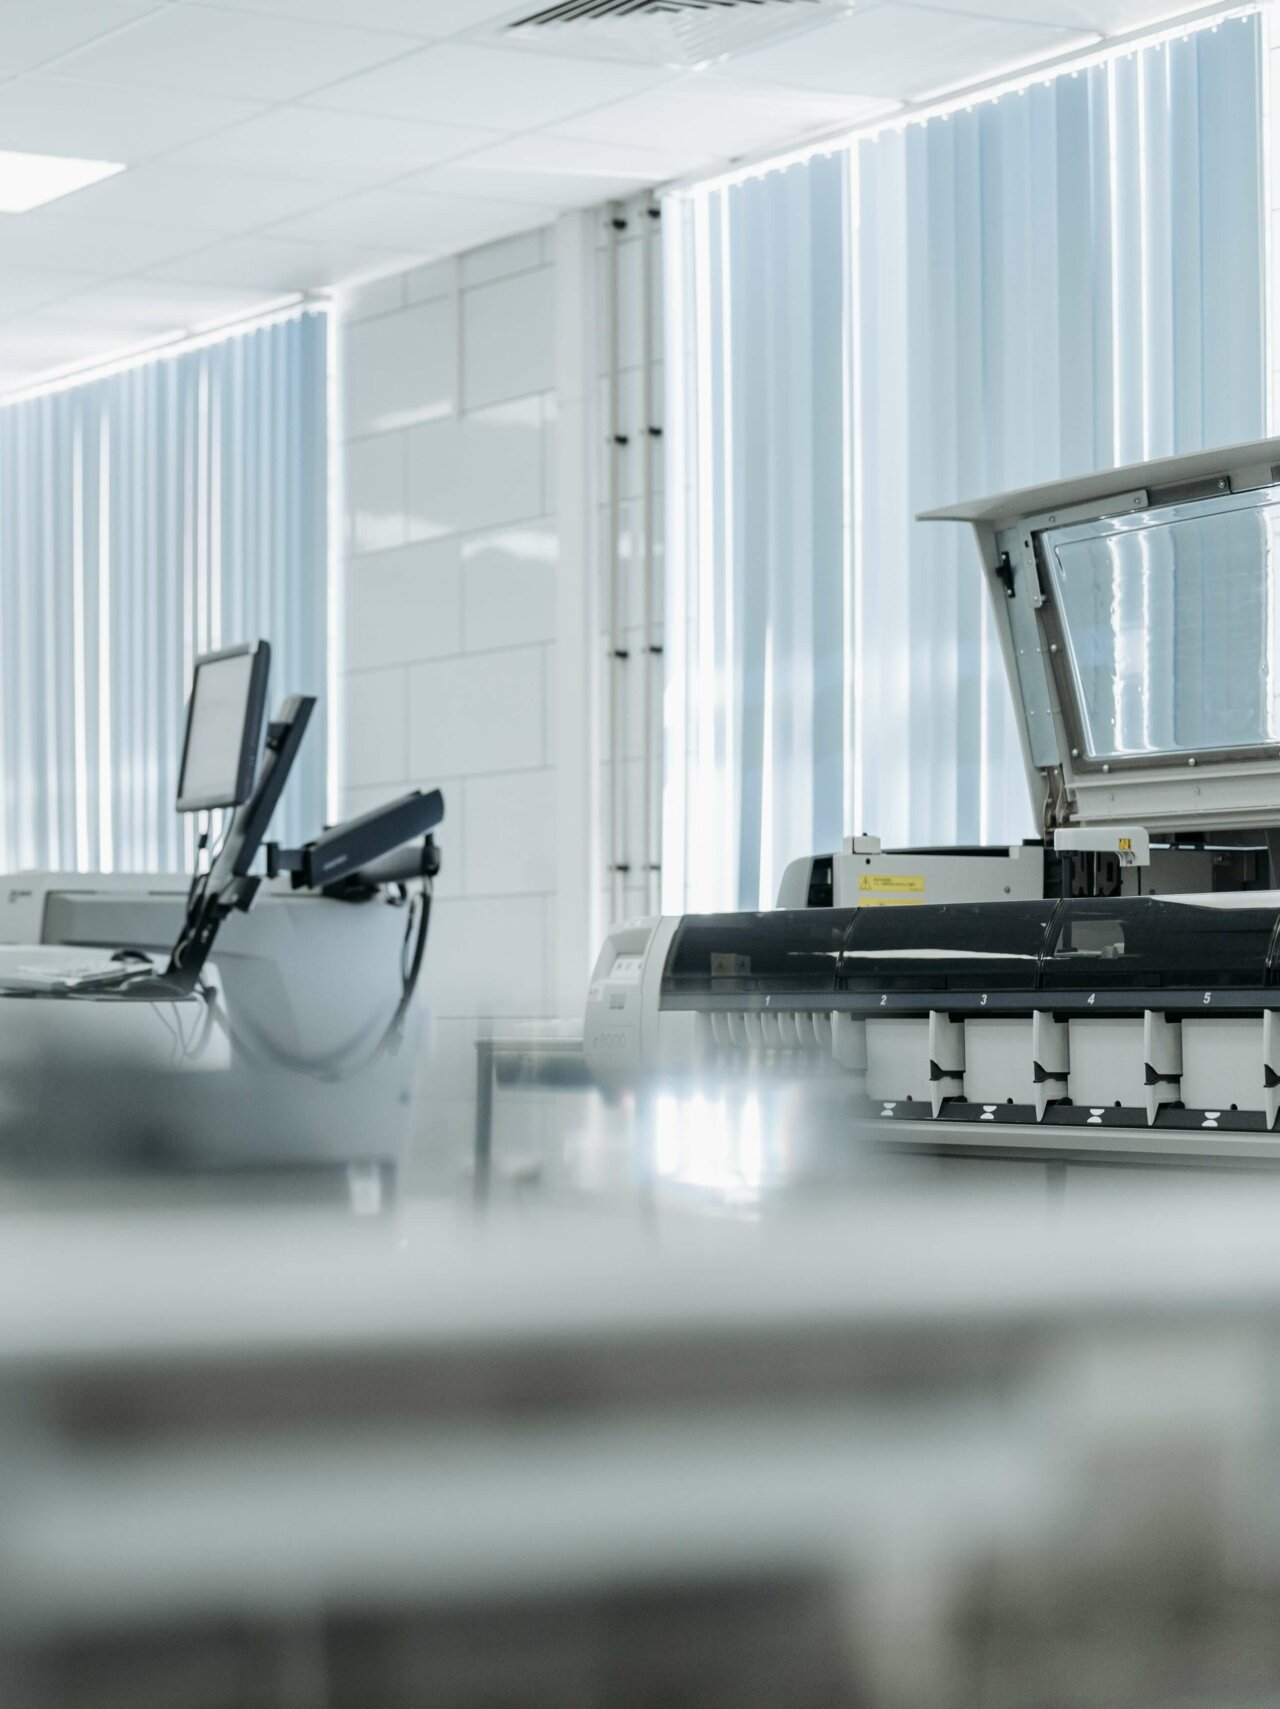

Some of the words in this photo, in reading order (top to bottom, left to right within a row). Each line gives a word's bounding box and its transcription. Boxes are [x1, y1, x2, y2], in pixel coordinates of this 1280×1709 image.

[765, 995, 771, 1006] 1
[879, 994, 888, 1006] 2
[980, 994, 988, 1005] 3
[1087, 993, 1096, 1005] 4
[1202, 992, 1211, 1004] 5
